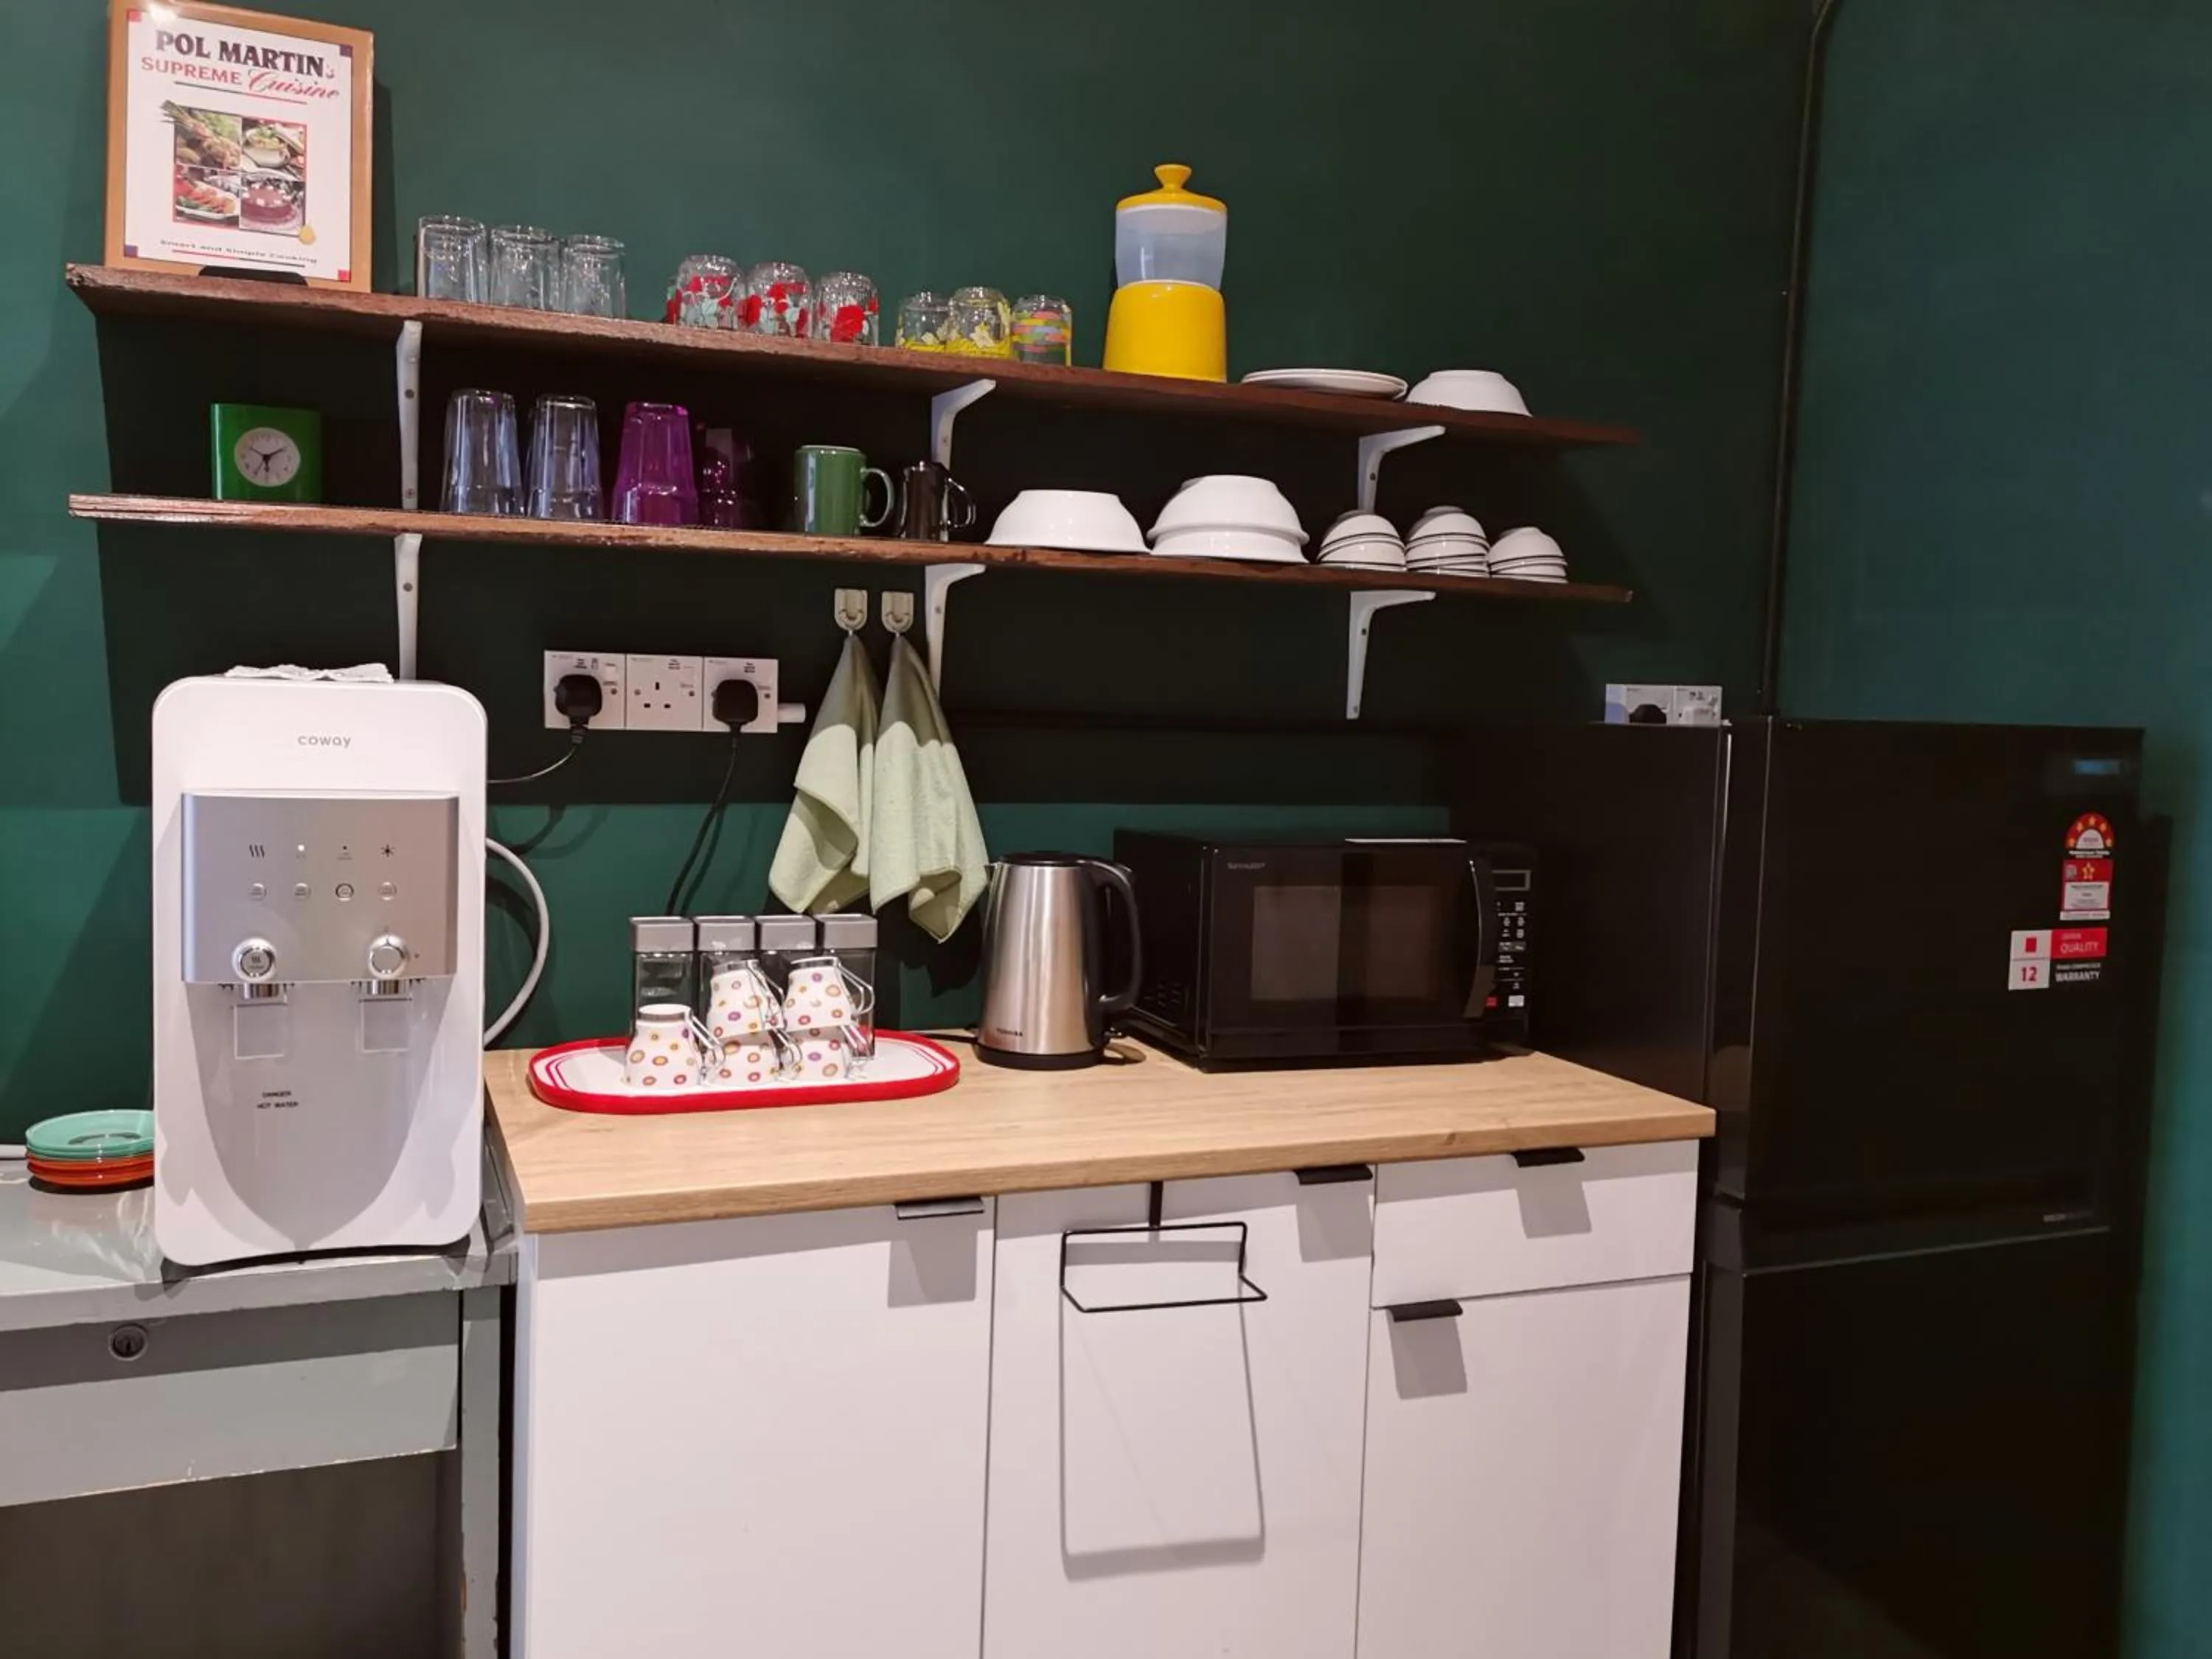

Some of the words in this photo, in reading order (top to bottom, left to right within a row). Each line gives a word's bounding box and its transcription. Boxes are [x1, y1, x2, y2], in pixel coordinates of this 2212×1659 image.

[156, 29, 211, 59] POL
[141, 57, 242, 86] SUPREME
[248, 69, 340, 100] Cuisine
[297, 735, 352, 748] coway
[2060, 941, 2098, 955] QUALITY
[2021, 967, 2038, 983] 12
[2056, 970, 2099, 982] WARRANTY
